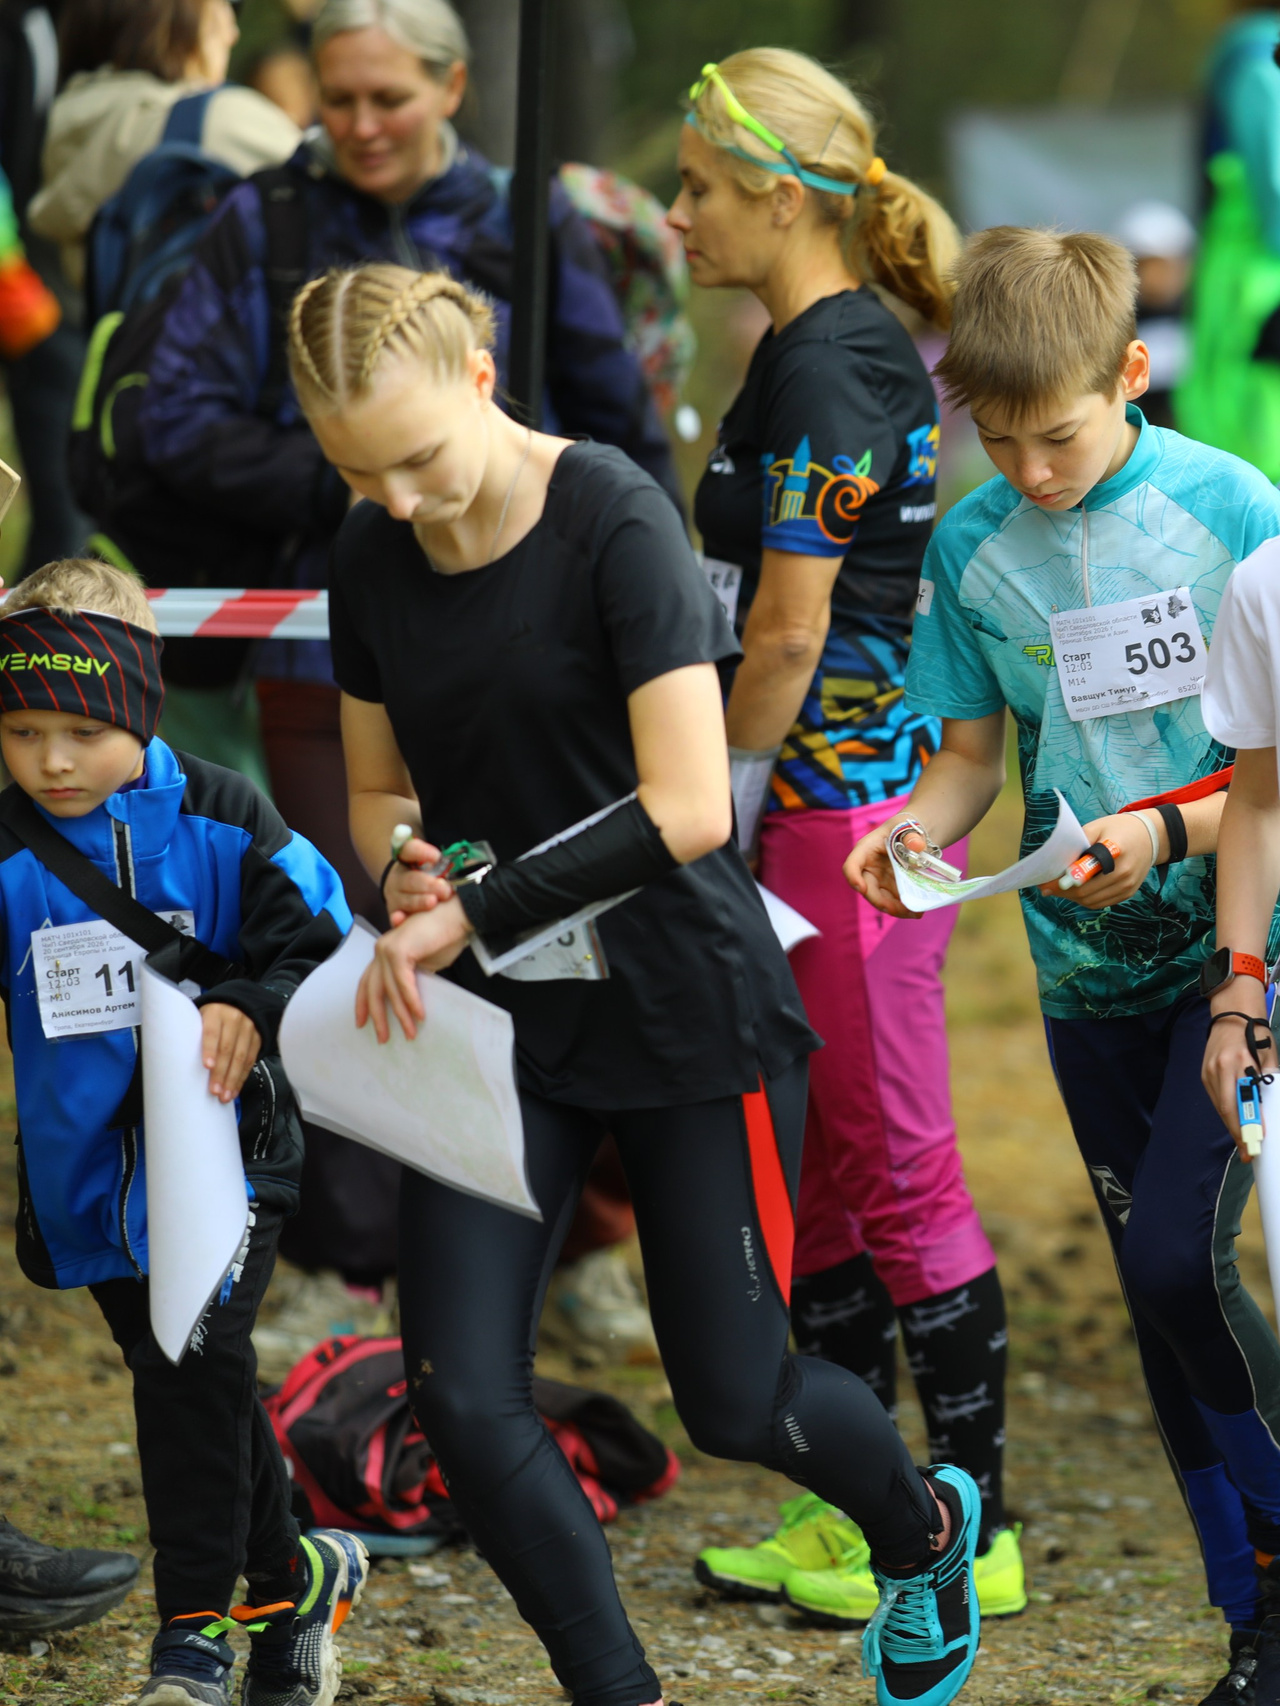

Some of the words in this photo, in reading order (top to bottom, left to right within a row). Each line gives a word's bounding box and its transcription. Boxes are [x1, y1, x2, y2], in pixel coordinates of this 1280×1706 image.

[1070, 620, 1110, 631] Свердловской
[1112, 615, 1138, 624] области
[1067, 630, 1092, 638] сентября
[1083, 634, 1106, 642] Европы
[1062, 652, 1092, 663] Старт
[1125, 632, 1196, 675] 503
[1065, 661, 1093, 674] 12:03
[1071, 691, 1106, 703] Вавщук
[1107, 685, 1137, 696] Тимур
[58, 934, 107, 946] Свердловской
[53, 944, 85, 954] сентября
[87, 940, 104, 948] 2026
[44, 953, 72, 962] граница
[73, 949, 100, 958] Европы
[46, 967, 81, 979] Старт
[48, 977, 80, 990] 12:03
[51, 1007, 102, 1019] Анисимов
[105, 1002, 135, 1013] Артем
[74, 1019, 114, 1029] Екатеринбург
